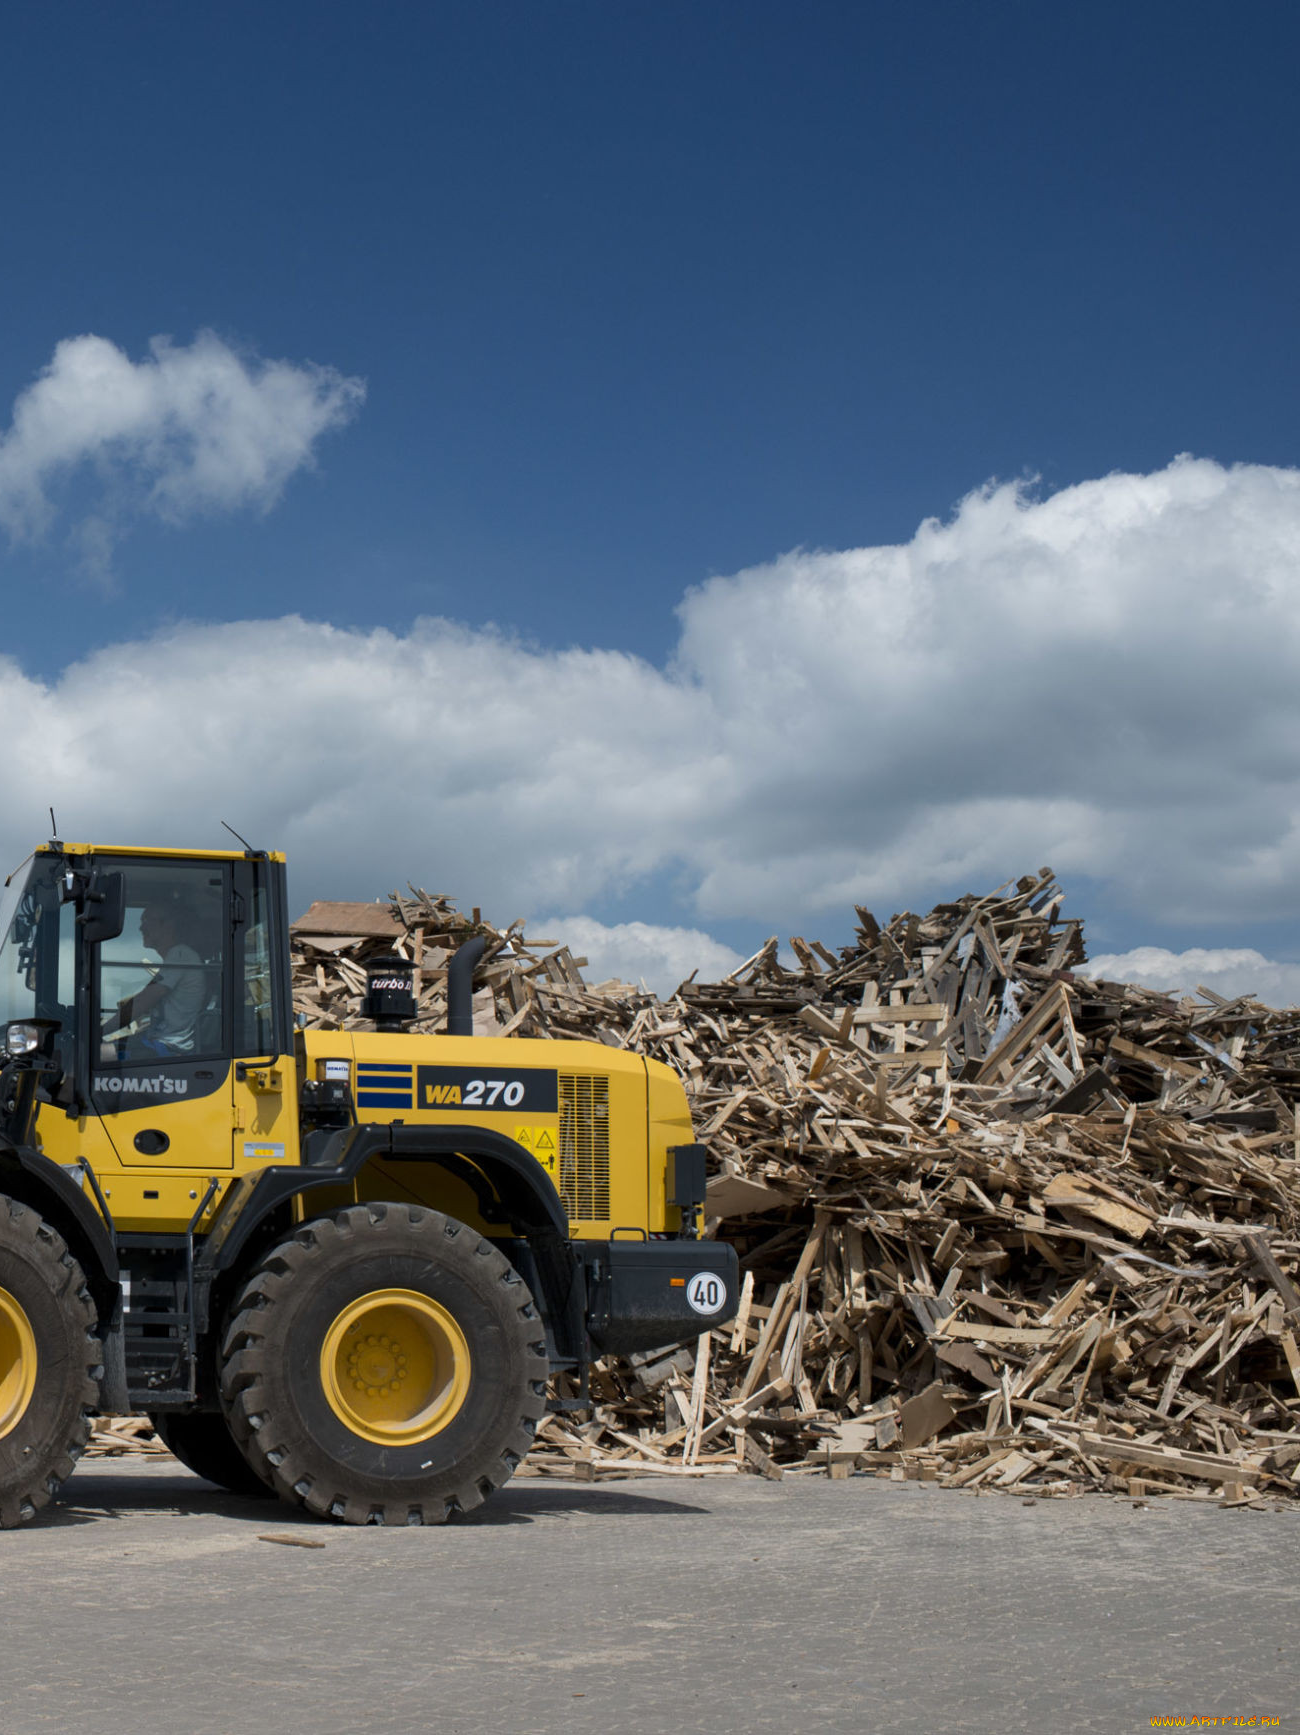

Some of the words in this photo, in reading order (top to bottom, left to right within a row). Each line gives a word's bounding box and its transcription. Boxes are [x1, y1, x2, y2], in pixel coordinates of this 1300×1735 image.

[371, 978, 404, 990] turbo
[94, 1075, 187, 1094] KOMATSU
[425, 1080, 525, 1106] WA270
[694, 1281, 718, 1306] 40
